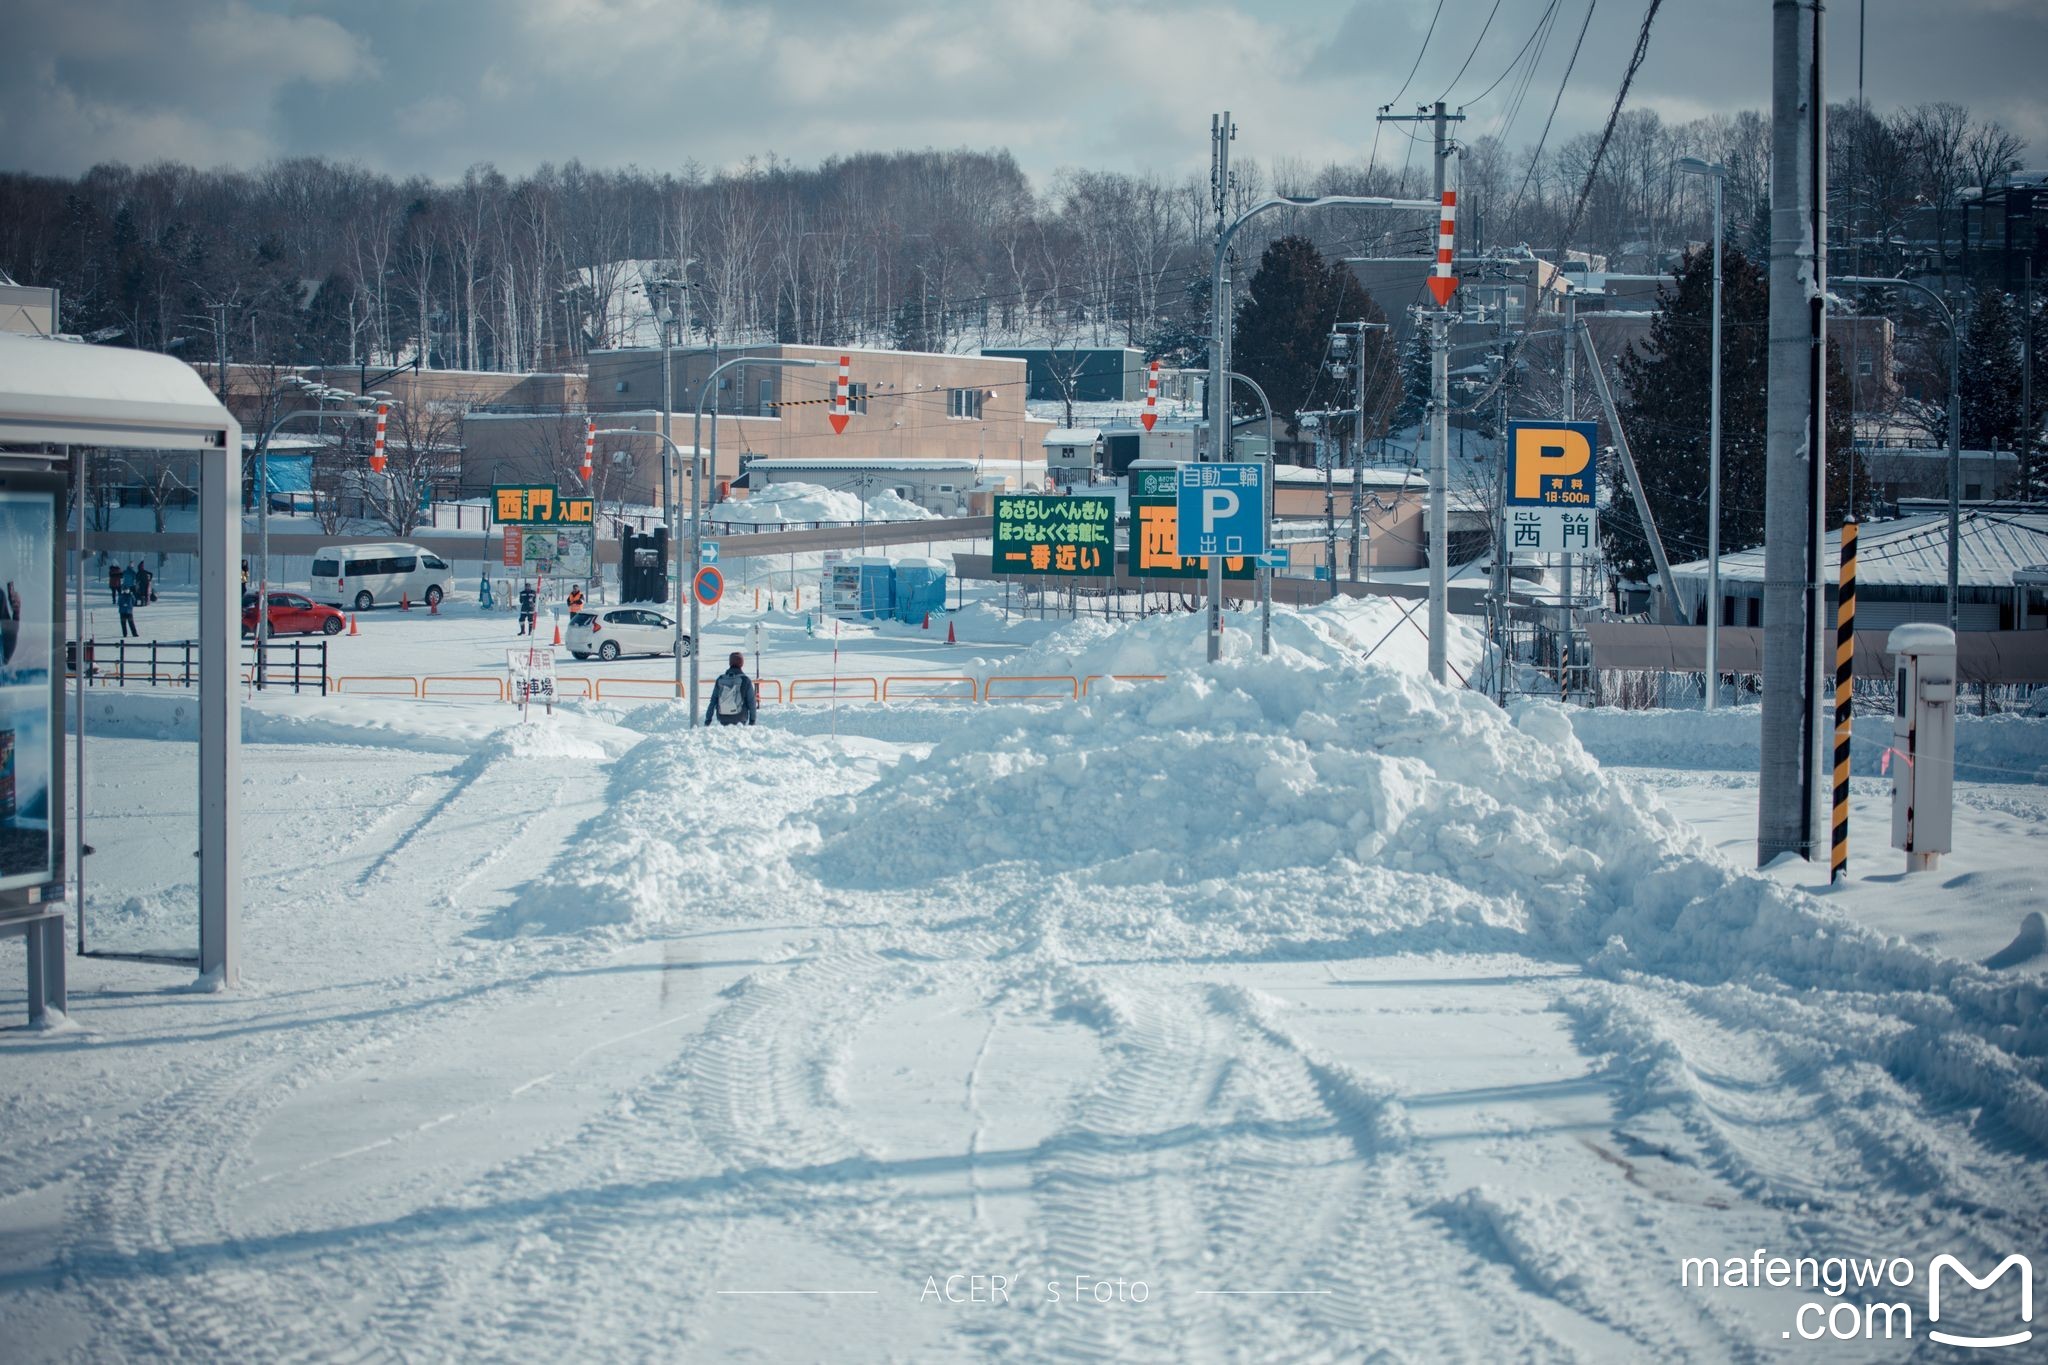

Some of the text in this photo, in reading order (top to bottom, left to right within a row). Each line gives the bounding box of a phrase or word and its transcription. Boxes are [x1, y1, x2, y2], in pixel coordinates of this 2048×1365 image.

[1515, 428, 1591, 498] P
[1182, 466, 1258, 488] 自動二輪
[1551, 478, 1583, 490] 有料
[497, 489, 553, 520] 西門
[1202, 489, 1240, 533] P
[1200, 535, 1242, 553] 出口
[1514, 523, 1589, 549] 西門
[1005, 544, 1100, 571] 一番近い
